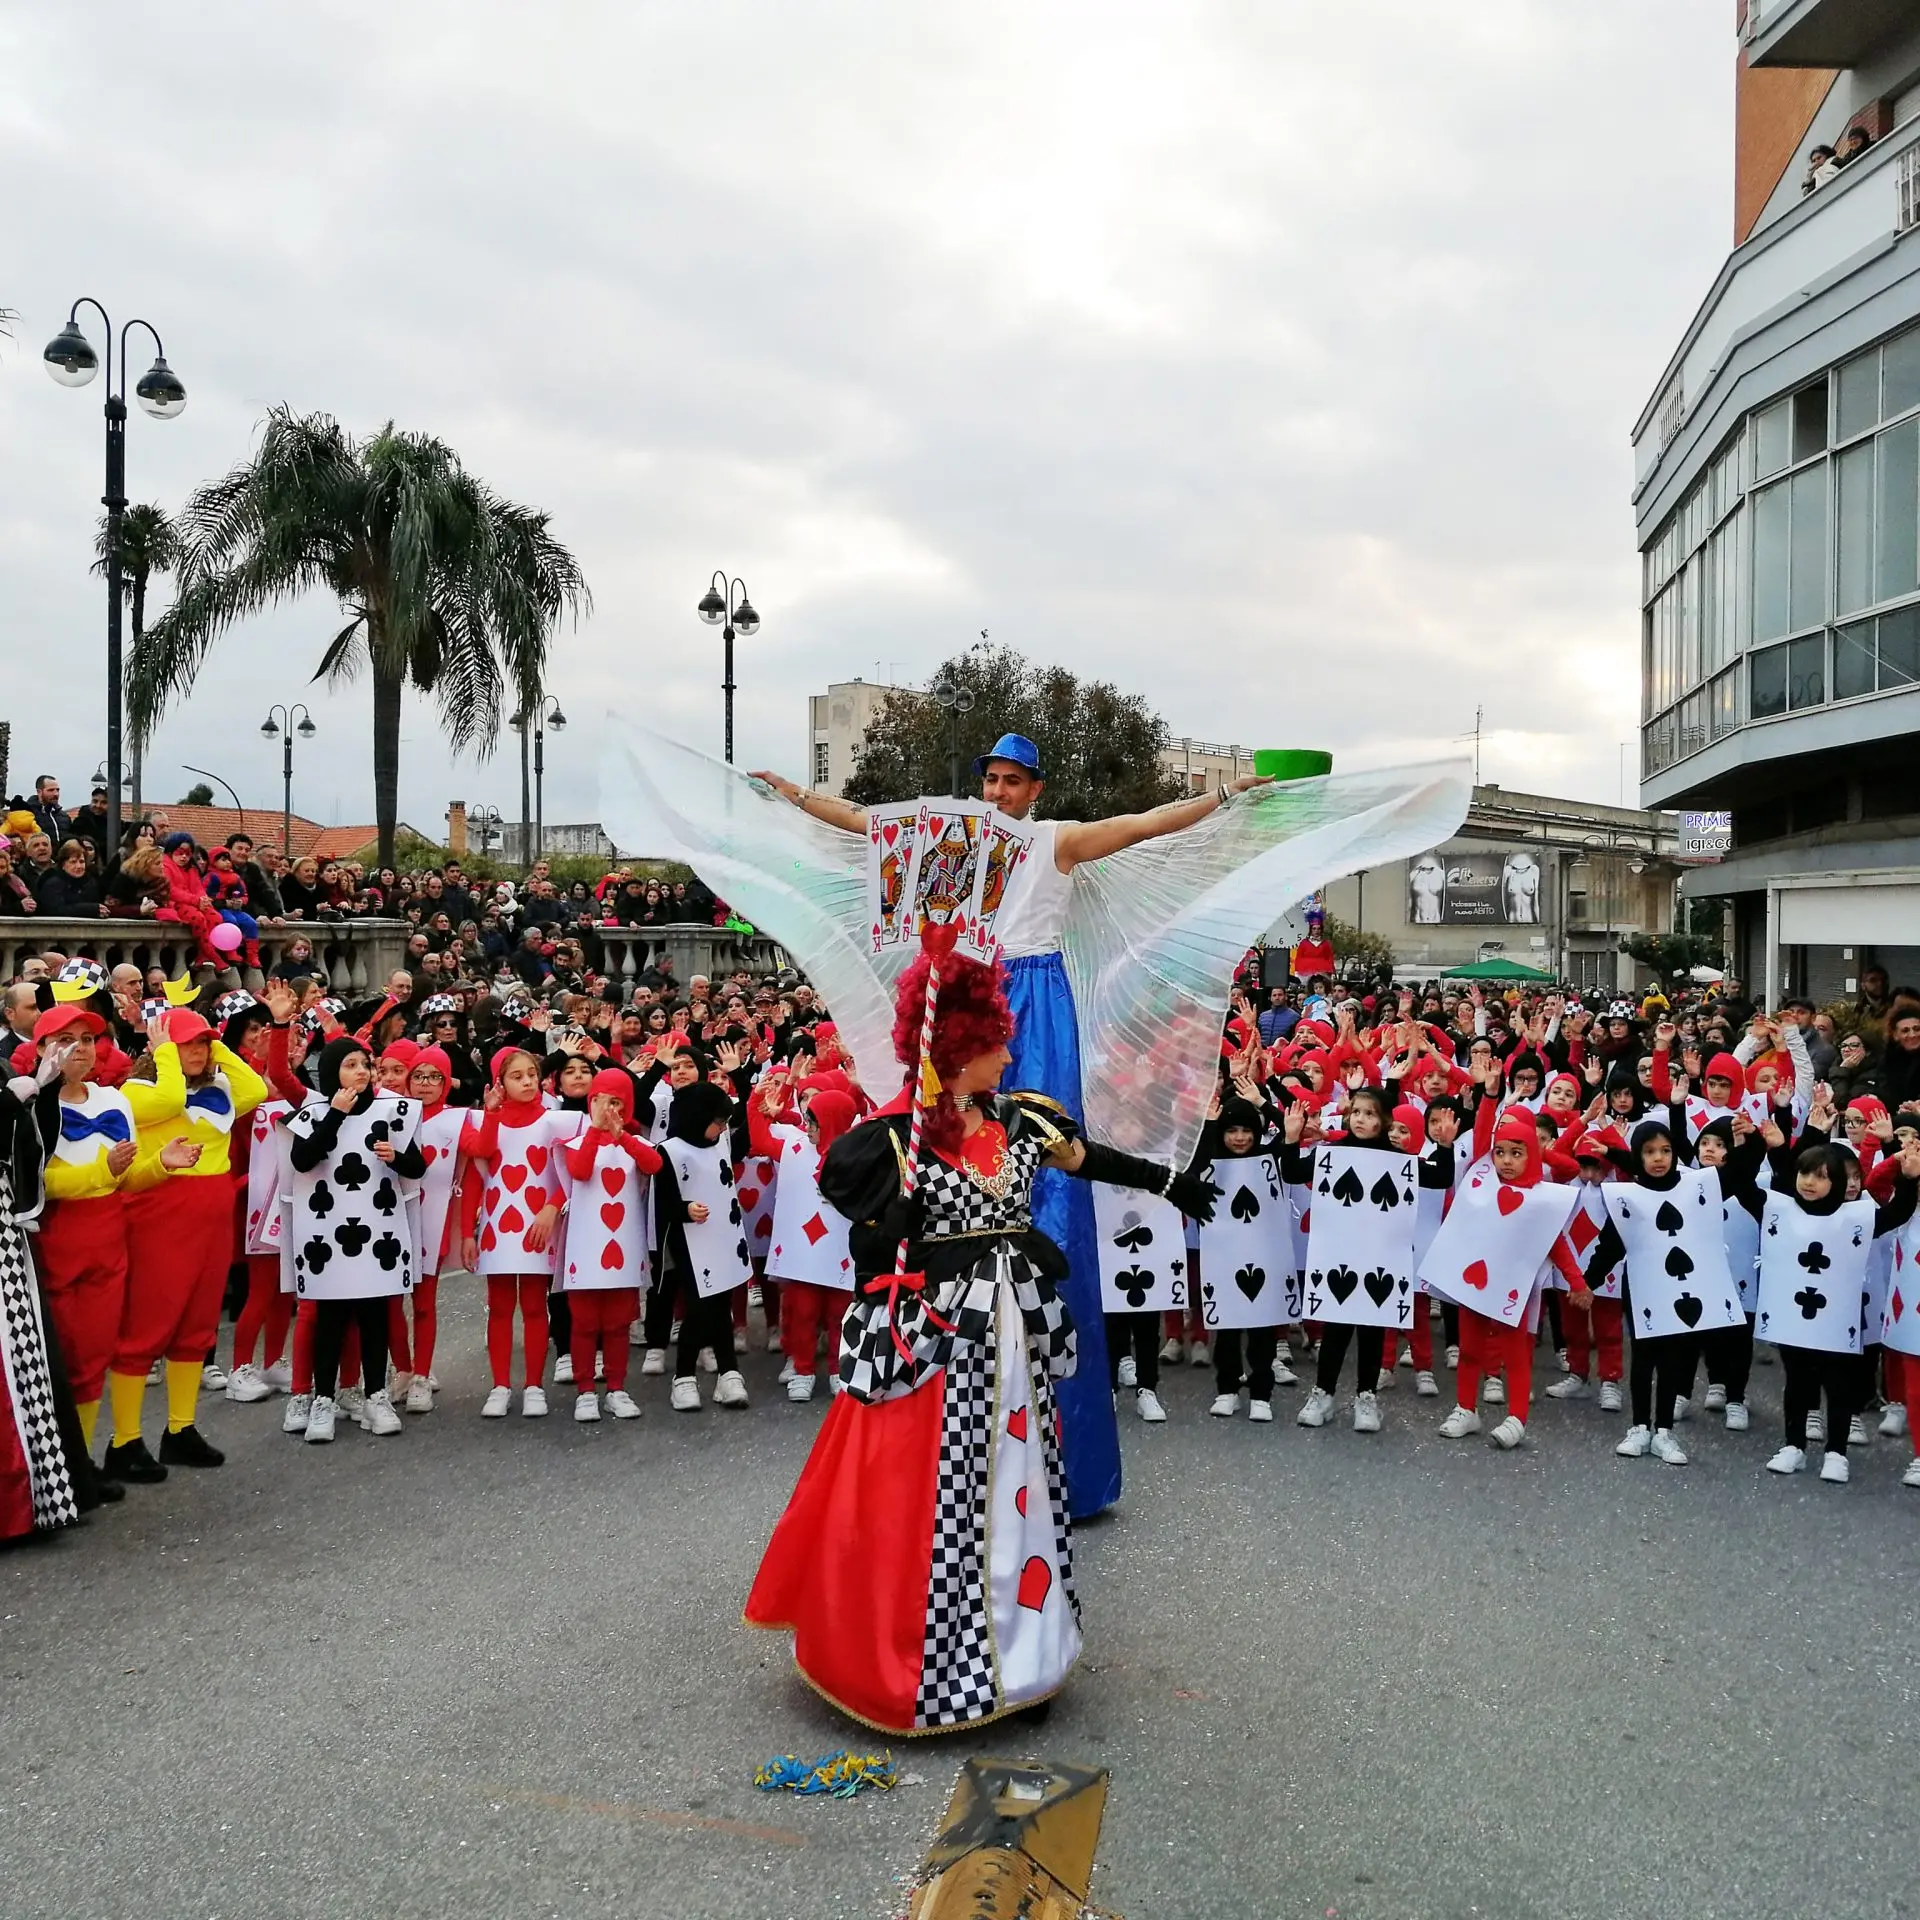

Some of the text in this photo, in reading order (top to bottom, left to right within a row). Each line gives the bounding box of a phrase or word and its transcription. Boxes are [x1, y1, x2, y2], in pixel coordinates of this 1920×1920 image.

[920, 805, 928, 822] Q
[984, 811, 991, 827] Q
[871, 814, 881, 831] K
[1022, 837, 1035, 852] J
[1473, 907, 1495, 915] ABITO
[872, 936, 882, 953] K
[1278, 937, 1284, 945] 6
[1297, 933, 1302, 941] 5
[397, 1100, 409, 1116] 8
[1261, 1159, 1277, 1182] 2
[1318, 1151, 1333, 1174] 4
[1401, 1160, 1414, 1182] 4
[1475, 1163, 1491, 1179] 2
[1771, 1213, 1780, 1226] 2
[297, 1274, 306, 1293] 8
[402, 1269, 411, 1288] 8
[1171, 1280, 1185, 1305] 3
[1285, 1293, 1301, 1318] 2
[1308, 1292, 1323, 1316] 4
[1397, 1300, 1411, 1324] 4
[1203, 1301, 1220, 1325] 2
